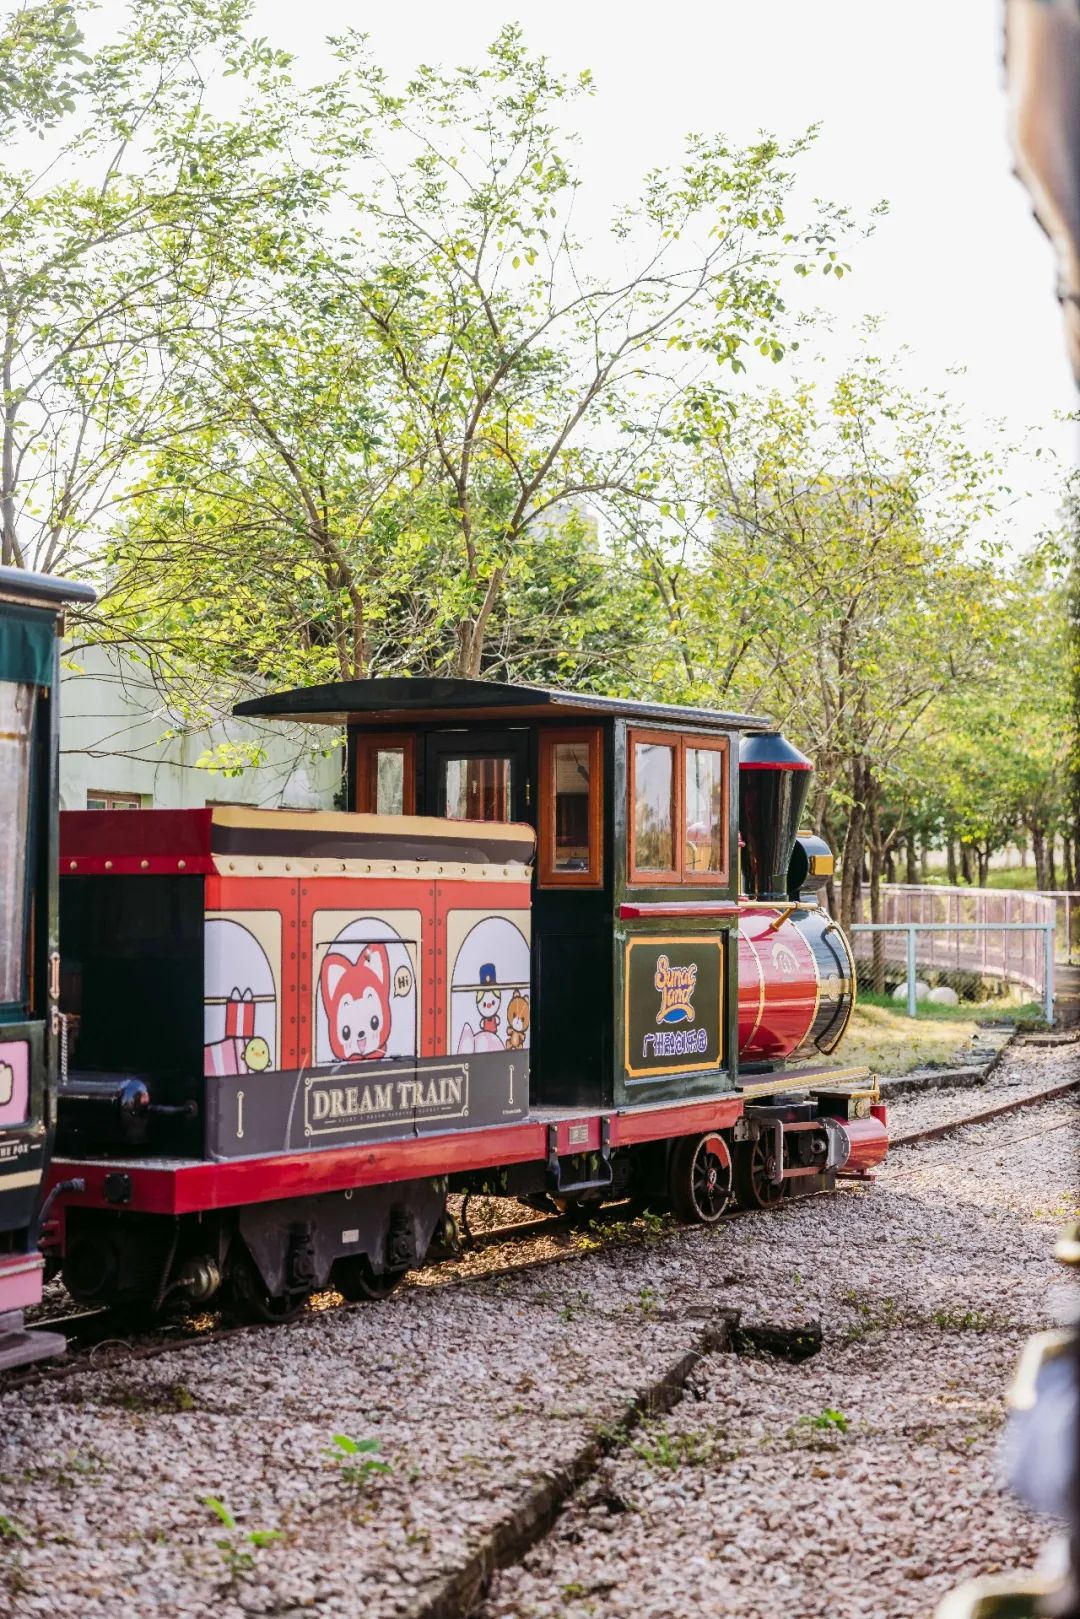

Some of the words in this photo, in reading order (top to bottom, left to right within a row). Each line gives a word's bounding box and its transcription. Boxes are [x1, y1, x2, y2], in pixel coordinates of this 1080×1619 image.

[398, 976, 408, 989] Hi
[655, 955, 697, 991] Sunac
[312, 1083, 393, 1120] DREAM
[397, 1076, 463, 1109] TRAIN
